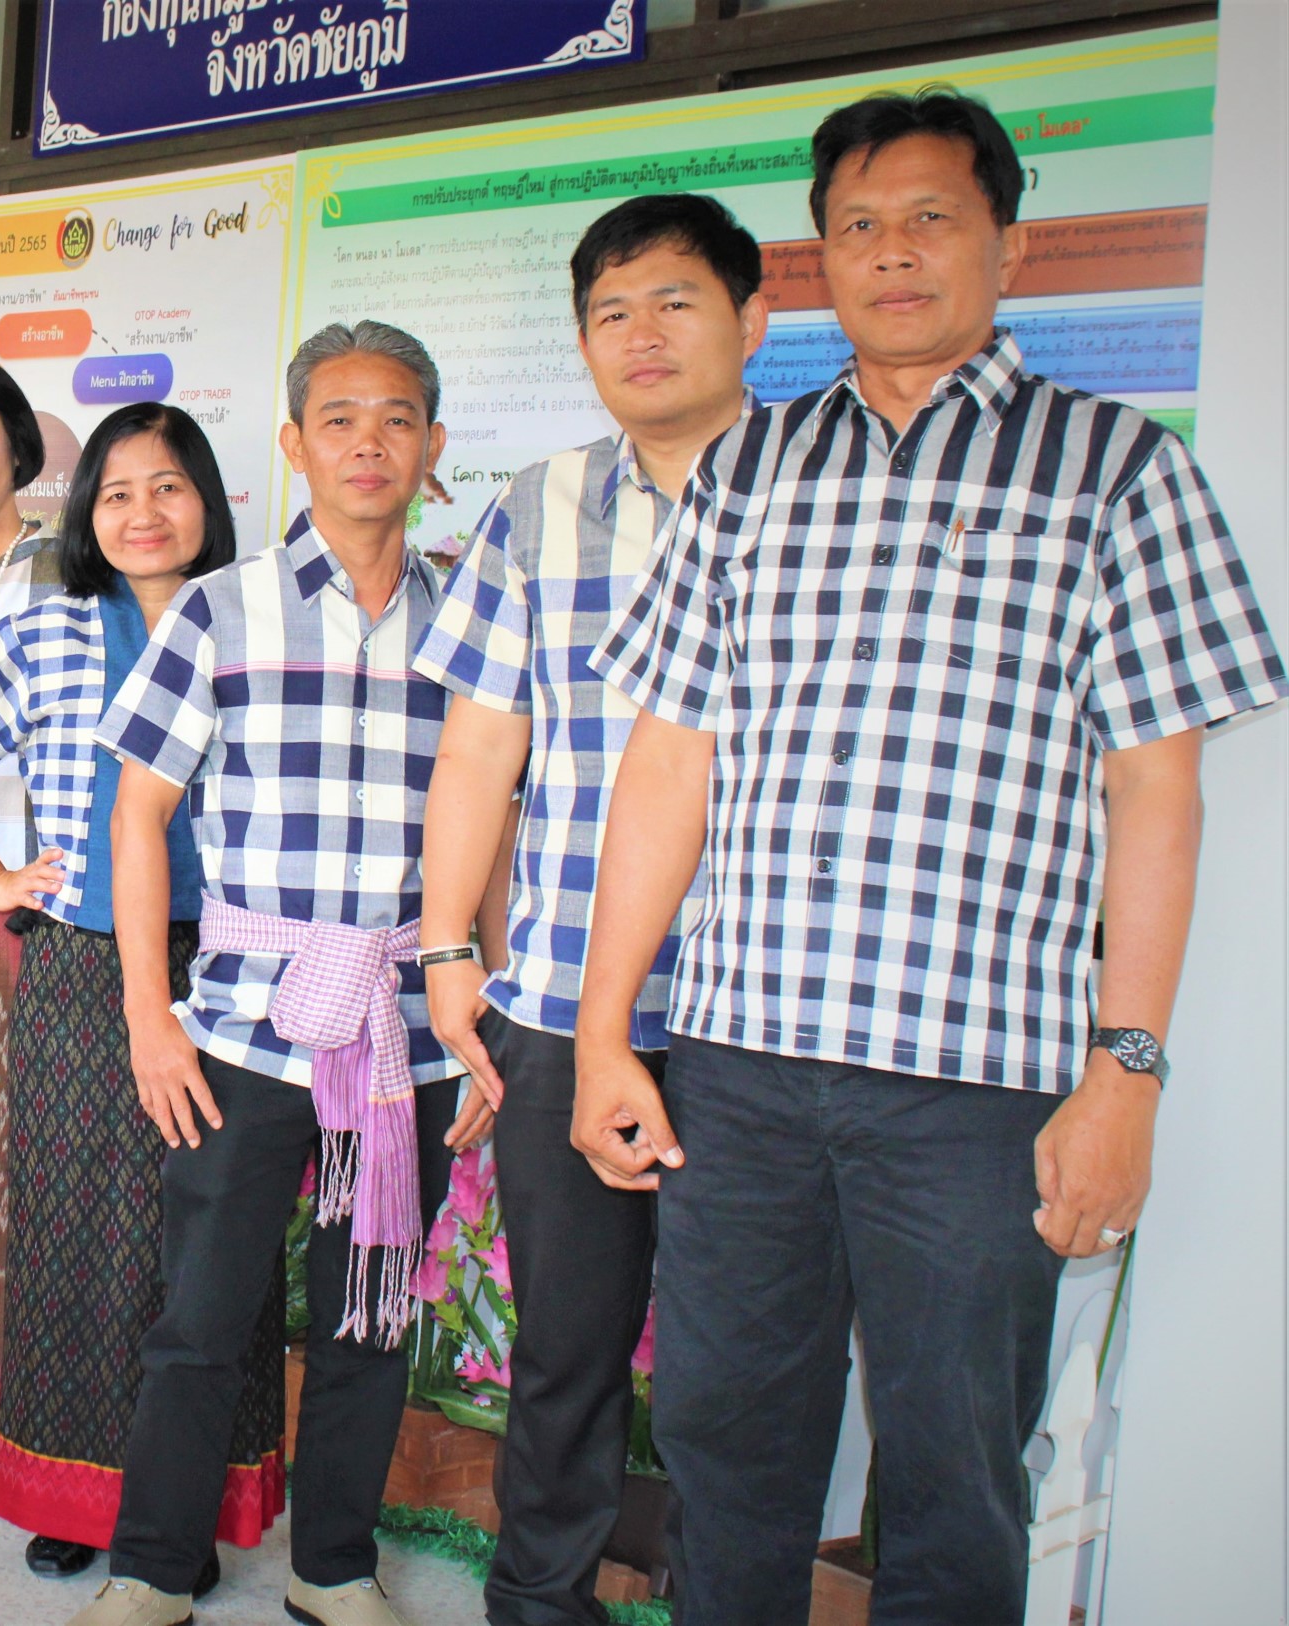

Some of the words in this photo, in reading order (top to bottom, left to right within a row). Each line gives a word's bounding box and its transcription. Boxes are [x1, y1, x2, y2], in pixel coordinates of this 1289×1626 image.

[205, 0, 408, 97] จังหวัดชัยภูมิ
[412, 178, 491, 207] การปรับประยุกต์
[493, 172, 545, 200] ทฤษฎีใหม่
[549, 146, 817, 198] สู่การปฏิบัติตามภูมิปัญญาท้องถิ่นที่เหมาะสมกับ
[102, 218, 163, 251] Change
[170, 214, 194, 250] for
[204, 201, 249, 240] Good
[20, 234, 47, 253] 2565
[135, 310, 156, 321] OTOP
[158, 308, 191, 320] Academy
[21, 325, 64, 343] สร้างอาชีพ
[90, 375, 117, 388] Menu
[119, 369, 155, 387] ฝึกอาชีพ
[179, 390, 200, 401] OTOP
[203, 388, 231, 400] TRADER
[452, 402, 458, 413] 3
[539, 401, 546, 411] 4
[452, 465, 484, 483] โคก
